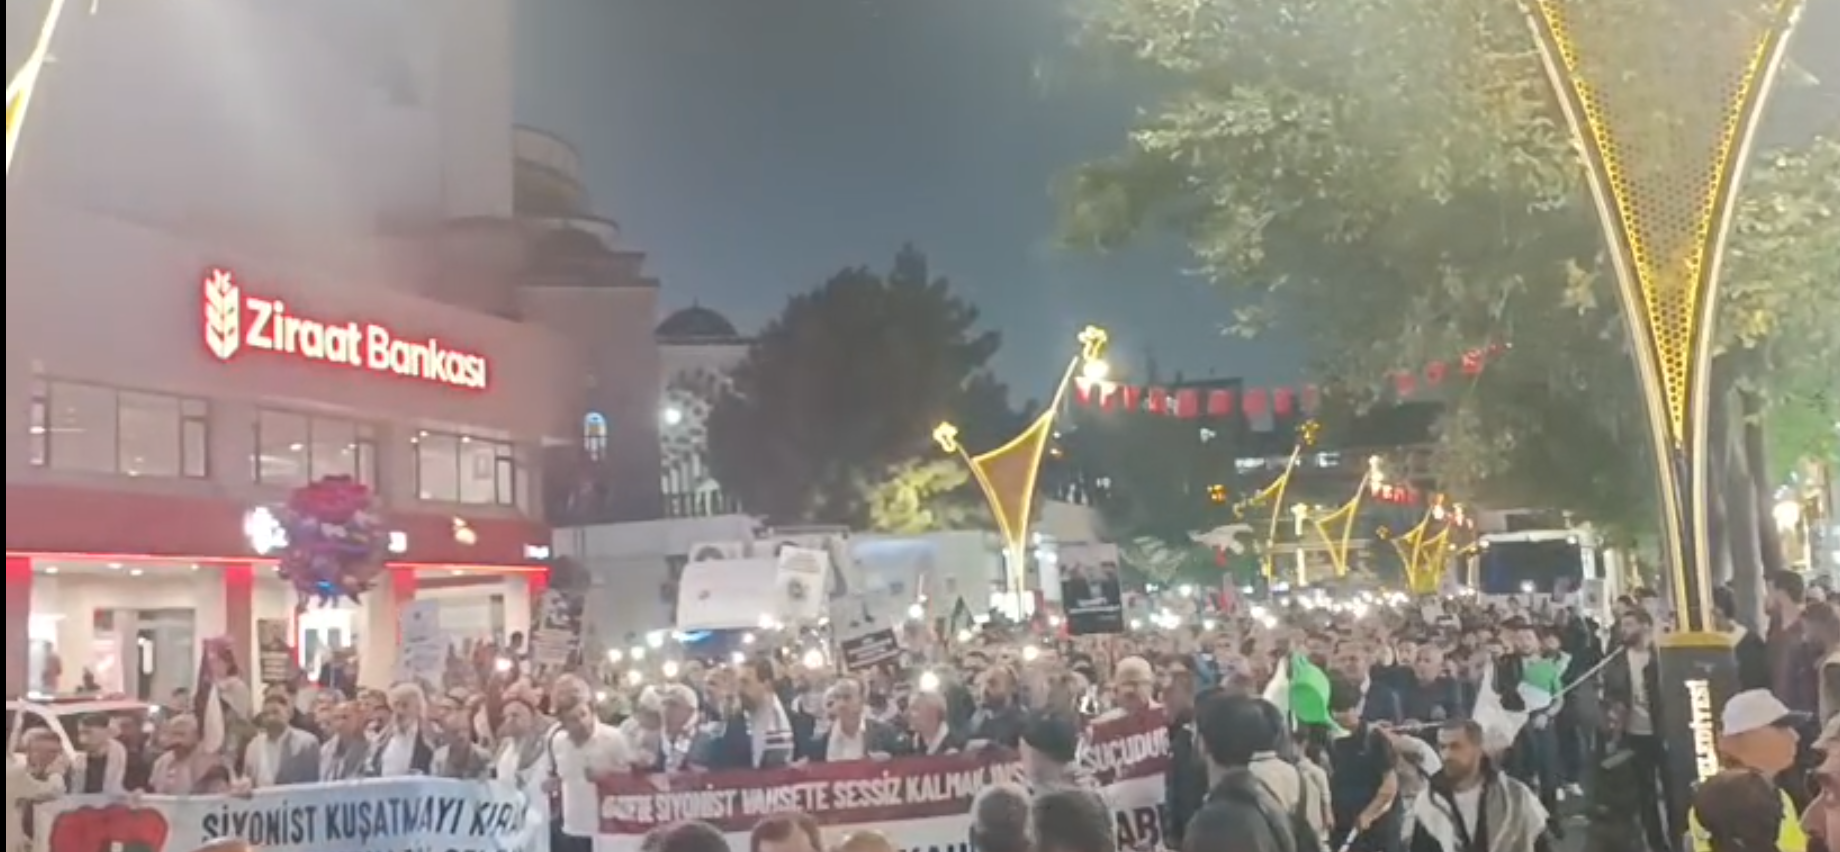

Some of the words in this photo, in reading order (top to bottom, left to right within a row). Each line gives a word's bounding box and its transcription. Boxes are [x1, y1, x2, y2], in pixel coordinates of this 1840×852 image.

[246, 297, 362, 366] Ziraat
[367, 325, 486, 388] Bankası
[833, 770, 902, 809] SESSİZ
[202, 800, 317, 846] SİYONİST
[326, 795, 465, 845] KUŞATMAYI
